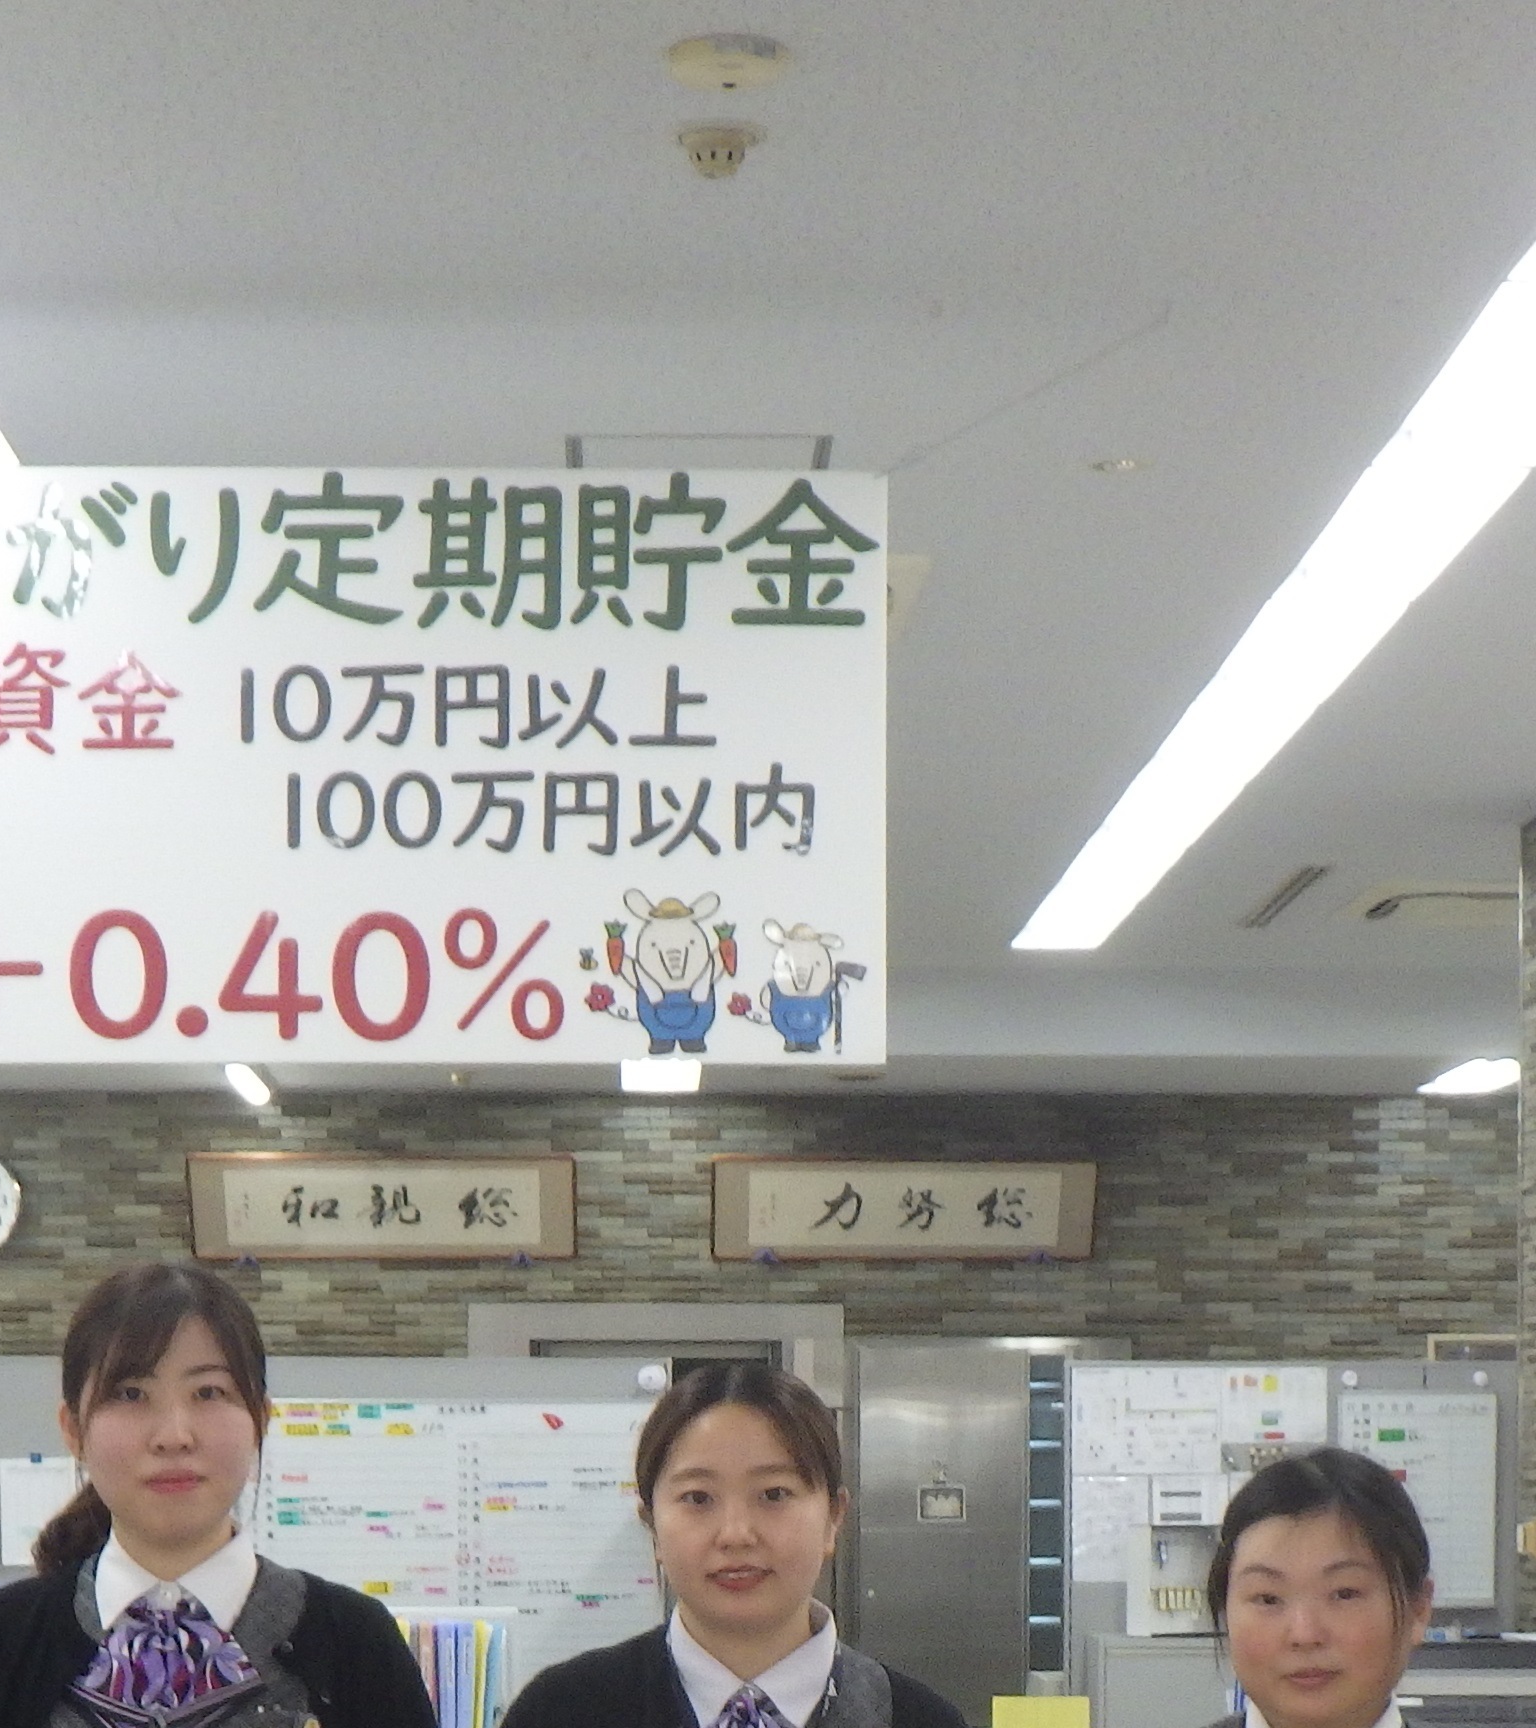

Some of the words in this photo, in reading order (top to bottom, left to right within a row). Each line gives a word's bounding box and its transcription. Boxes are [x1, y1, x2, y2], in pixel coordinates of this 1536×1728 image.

[239, 663, 718, 751] 10万円以上
[286, 763, 817, 858] 100万円以内
